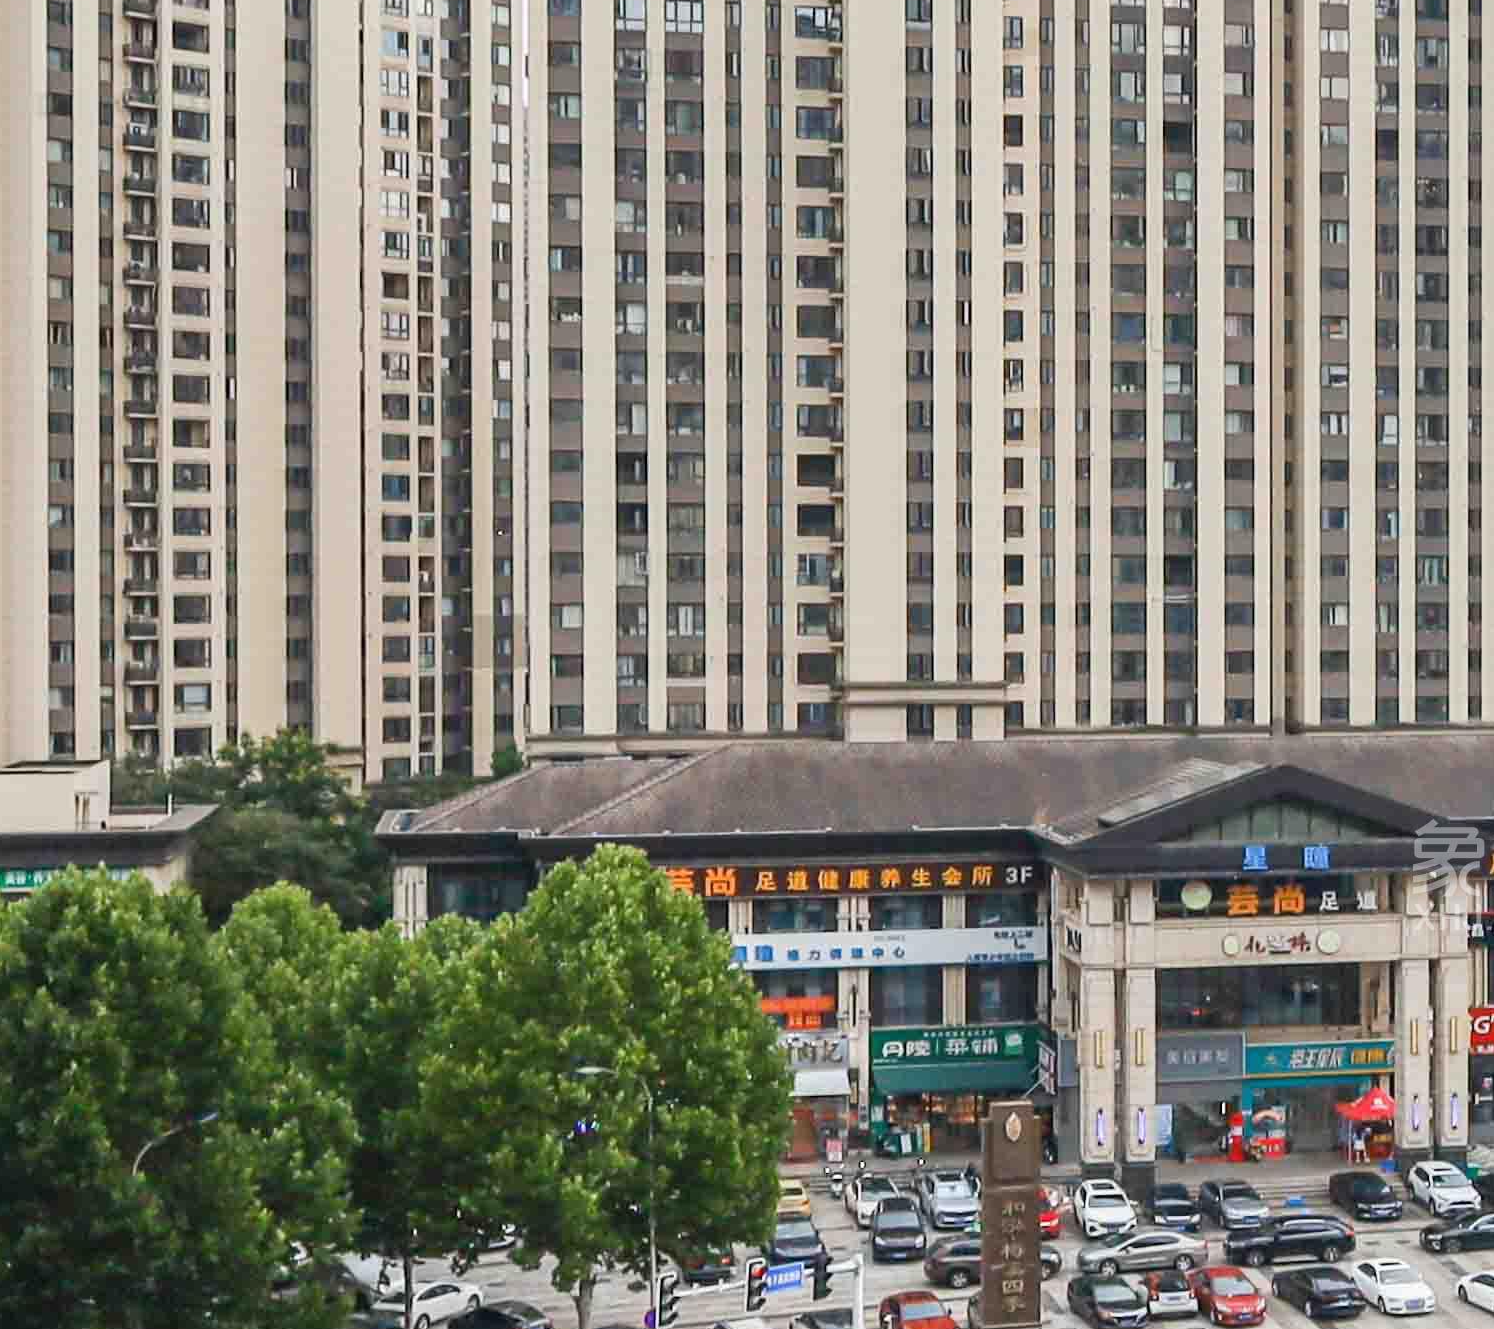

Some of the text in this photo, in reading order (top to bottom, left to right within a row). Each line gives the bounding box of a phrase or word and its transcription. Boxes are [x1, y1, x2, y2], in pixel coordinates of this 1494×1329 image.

[755, 865, 994, 892] 足道健康养生会所
[1006, 867, 1033, 885] 3F
[1319, 890, 1378, 913] 足道
